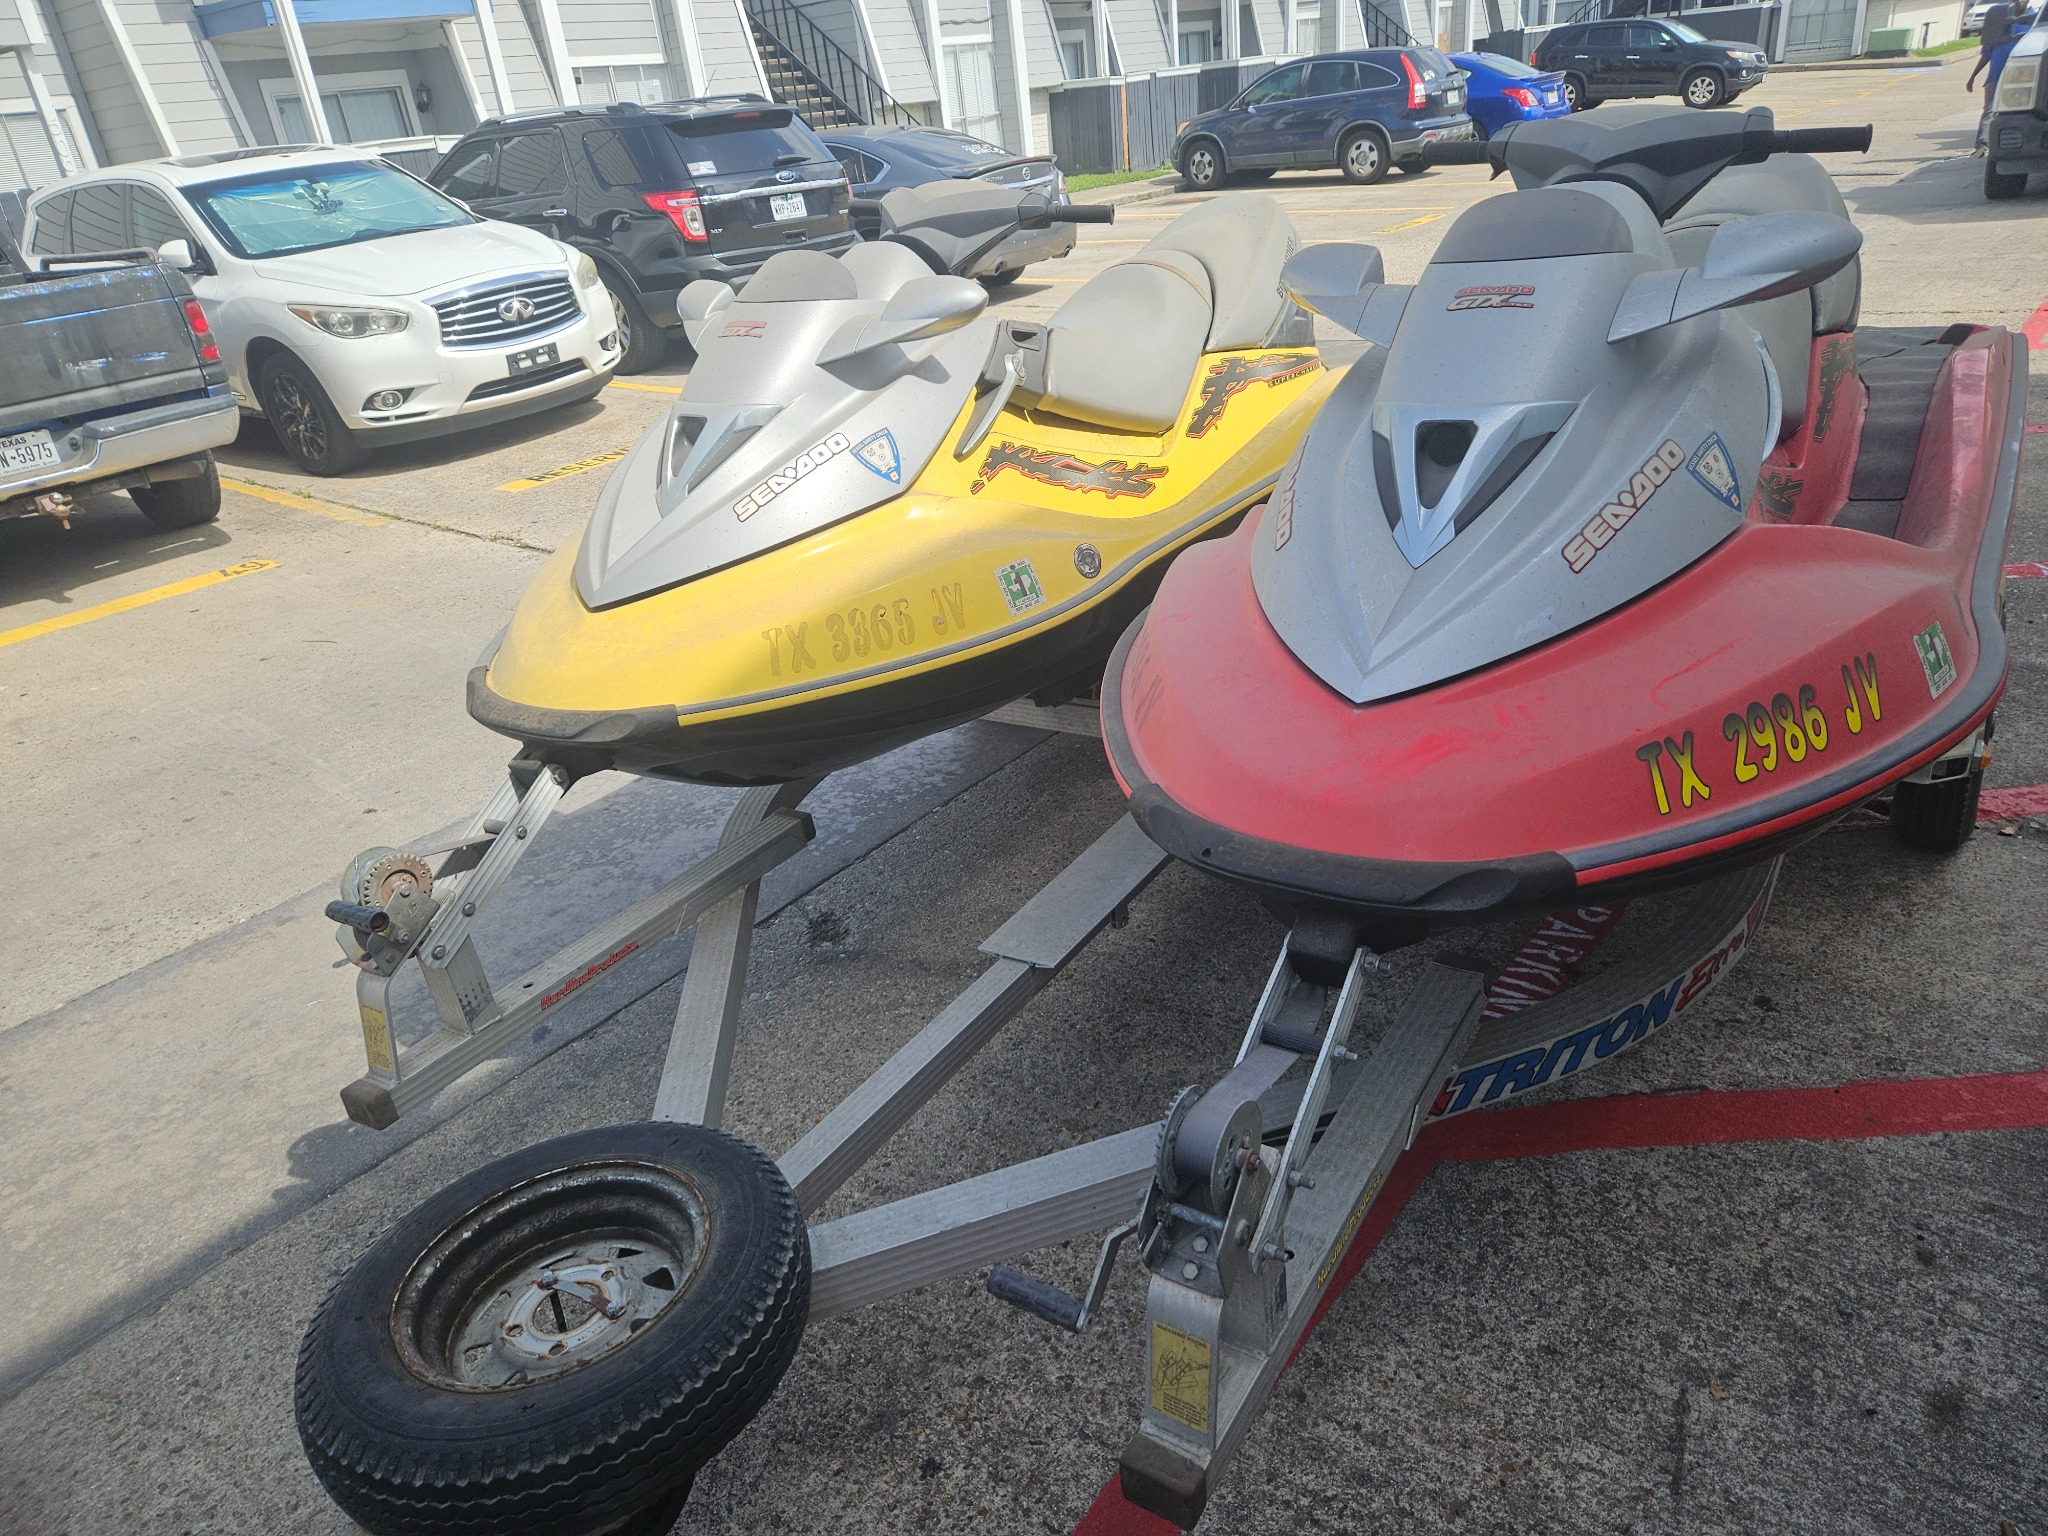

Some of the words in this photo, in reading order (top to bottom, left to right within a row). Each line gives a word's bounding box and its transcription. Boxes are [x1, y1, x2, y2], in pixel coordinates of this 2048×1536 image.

[1446, 294, 1518, 311] GTX
[0, 437, 27, 448] EXAS
[762, 621, 816, 677] TX
[931, 582, 967, 635] JV
[1637, 730, 1711, 816] TX
[1722, 683, 1829, 783] 2986
[1841, 652, 1882, 735] JV
[1448, 974, 1686, 1114] TRITON
